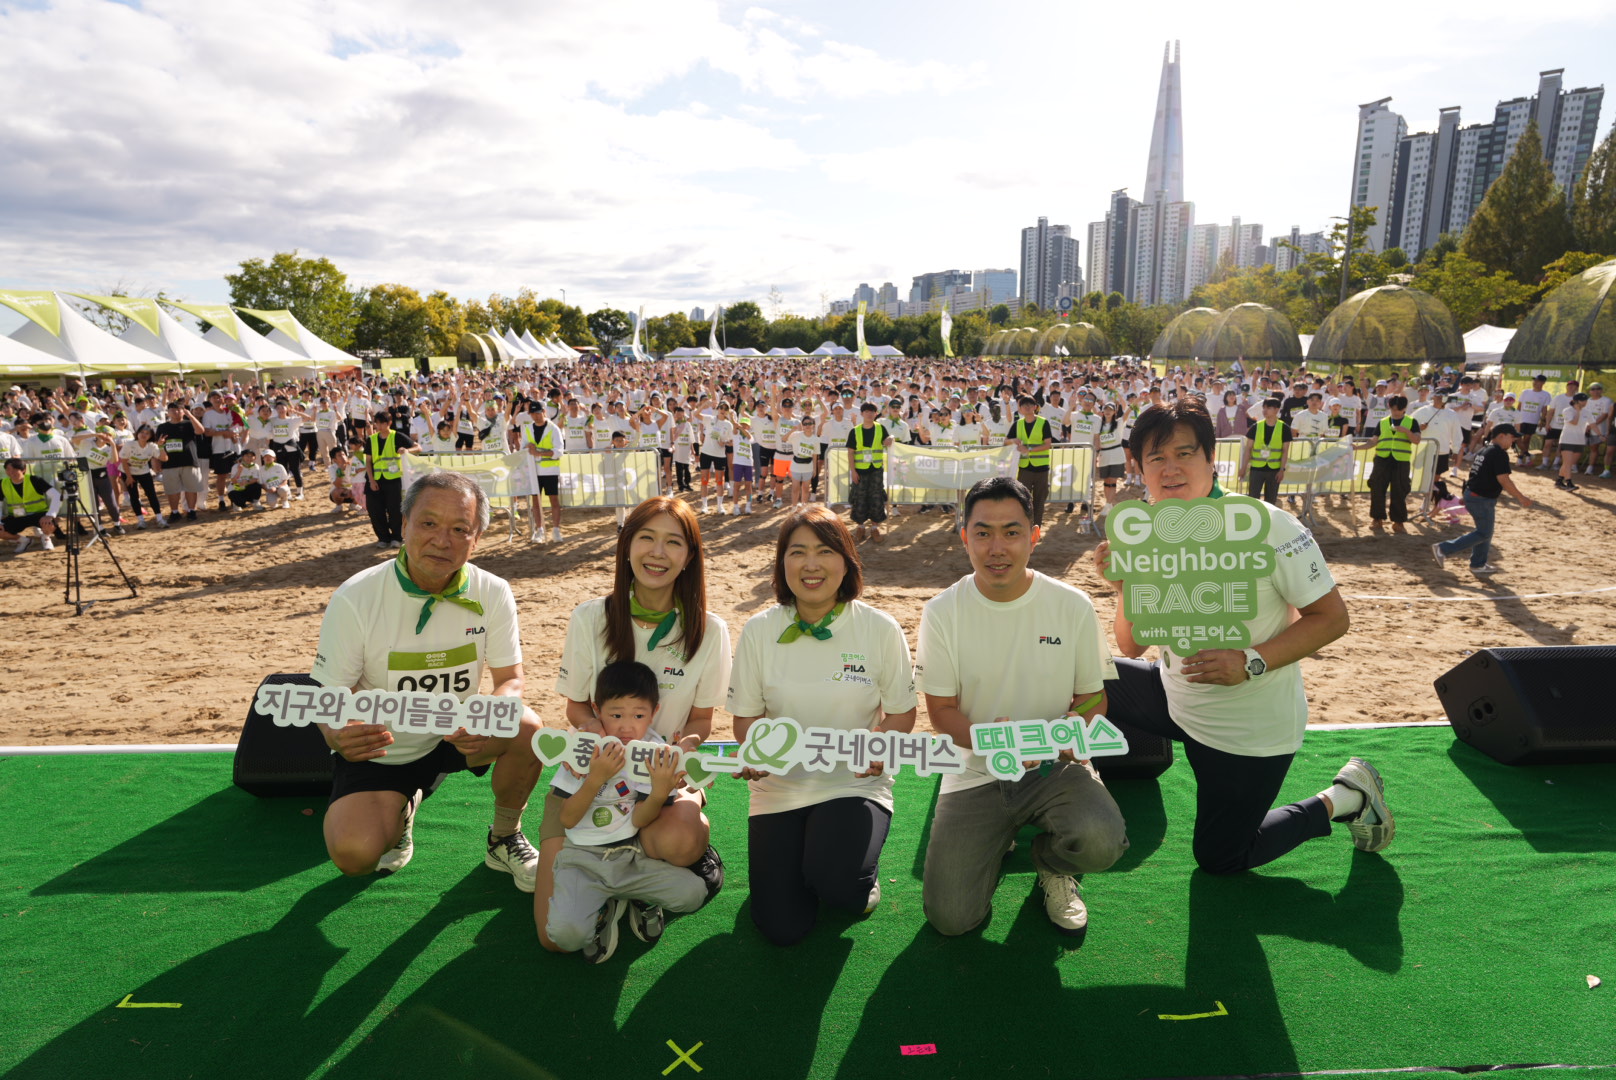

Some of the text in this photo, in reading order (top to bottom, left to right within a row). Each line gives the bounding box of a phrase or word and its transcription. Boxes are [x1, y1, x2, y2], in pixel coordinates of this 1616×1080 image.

[90, 452, 104, 461] 2117
[1113, 503, 1262, 545] GOOD
[1110, 546, 1268, 579] Neighbors
[1131, 581, 1250, 615] RACE
[465, 626, 486, 636] FILA
[1039, 636, 1061, 645] FILA
[1140, 625, 1243, 650] with 띵크어스
[397, 669, 471, 693] 0915
[663, 667, 685, 677] FILA
[844, 664, 866, 673] FILA
[262, 690, 519, 732] 지구와 아이들을 위한
[805, 730, 961, 773] 굿네이버스
[975, 719, 1123, 776] 띵크어스
